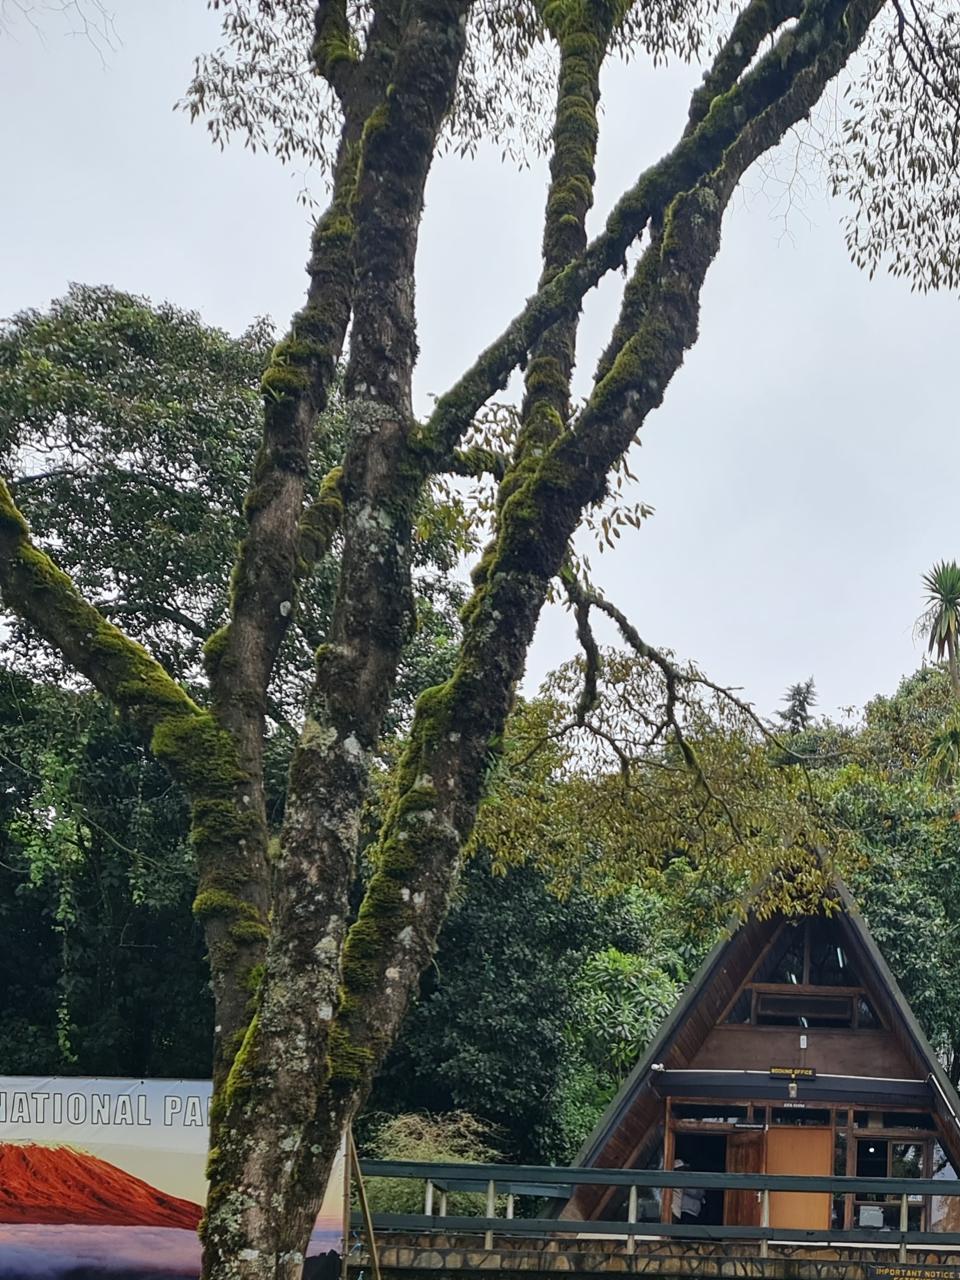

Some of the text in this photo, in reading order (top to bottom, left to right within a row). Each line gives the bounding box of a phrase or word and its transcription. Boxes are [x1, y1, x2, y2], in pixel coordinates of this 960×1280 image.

[163, 1095, 213, 1127] PA
[876, 1268, 922, 1277] IMPORTANT
[925, 1270, 955, 1279] NOTICE
